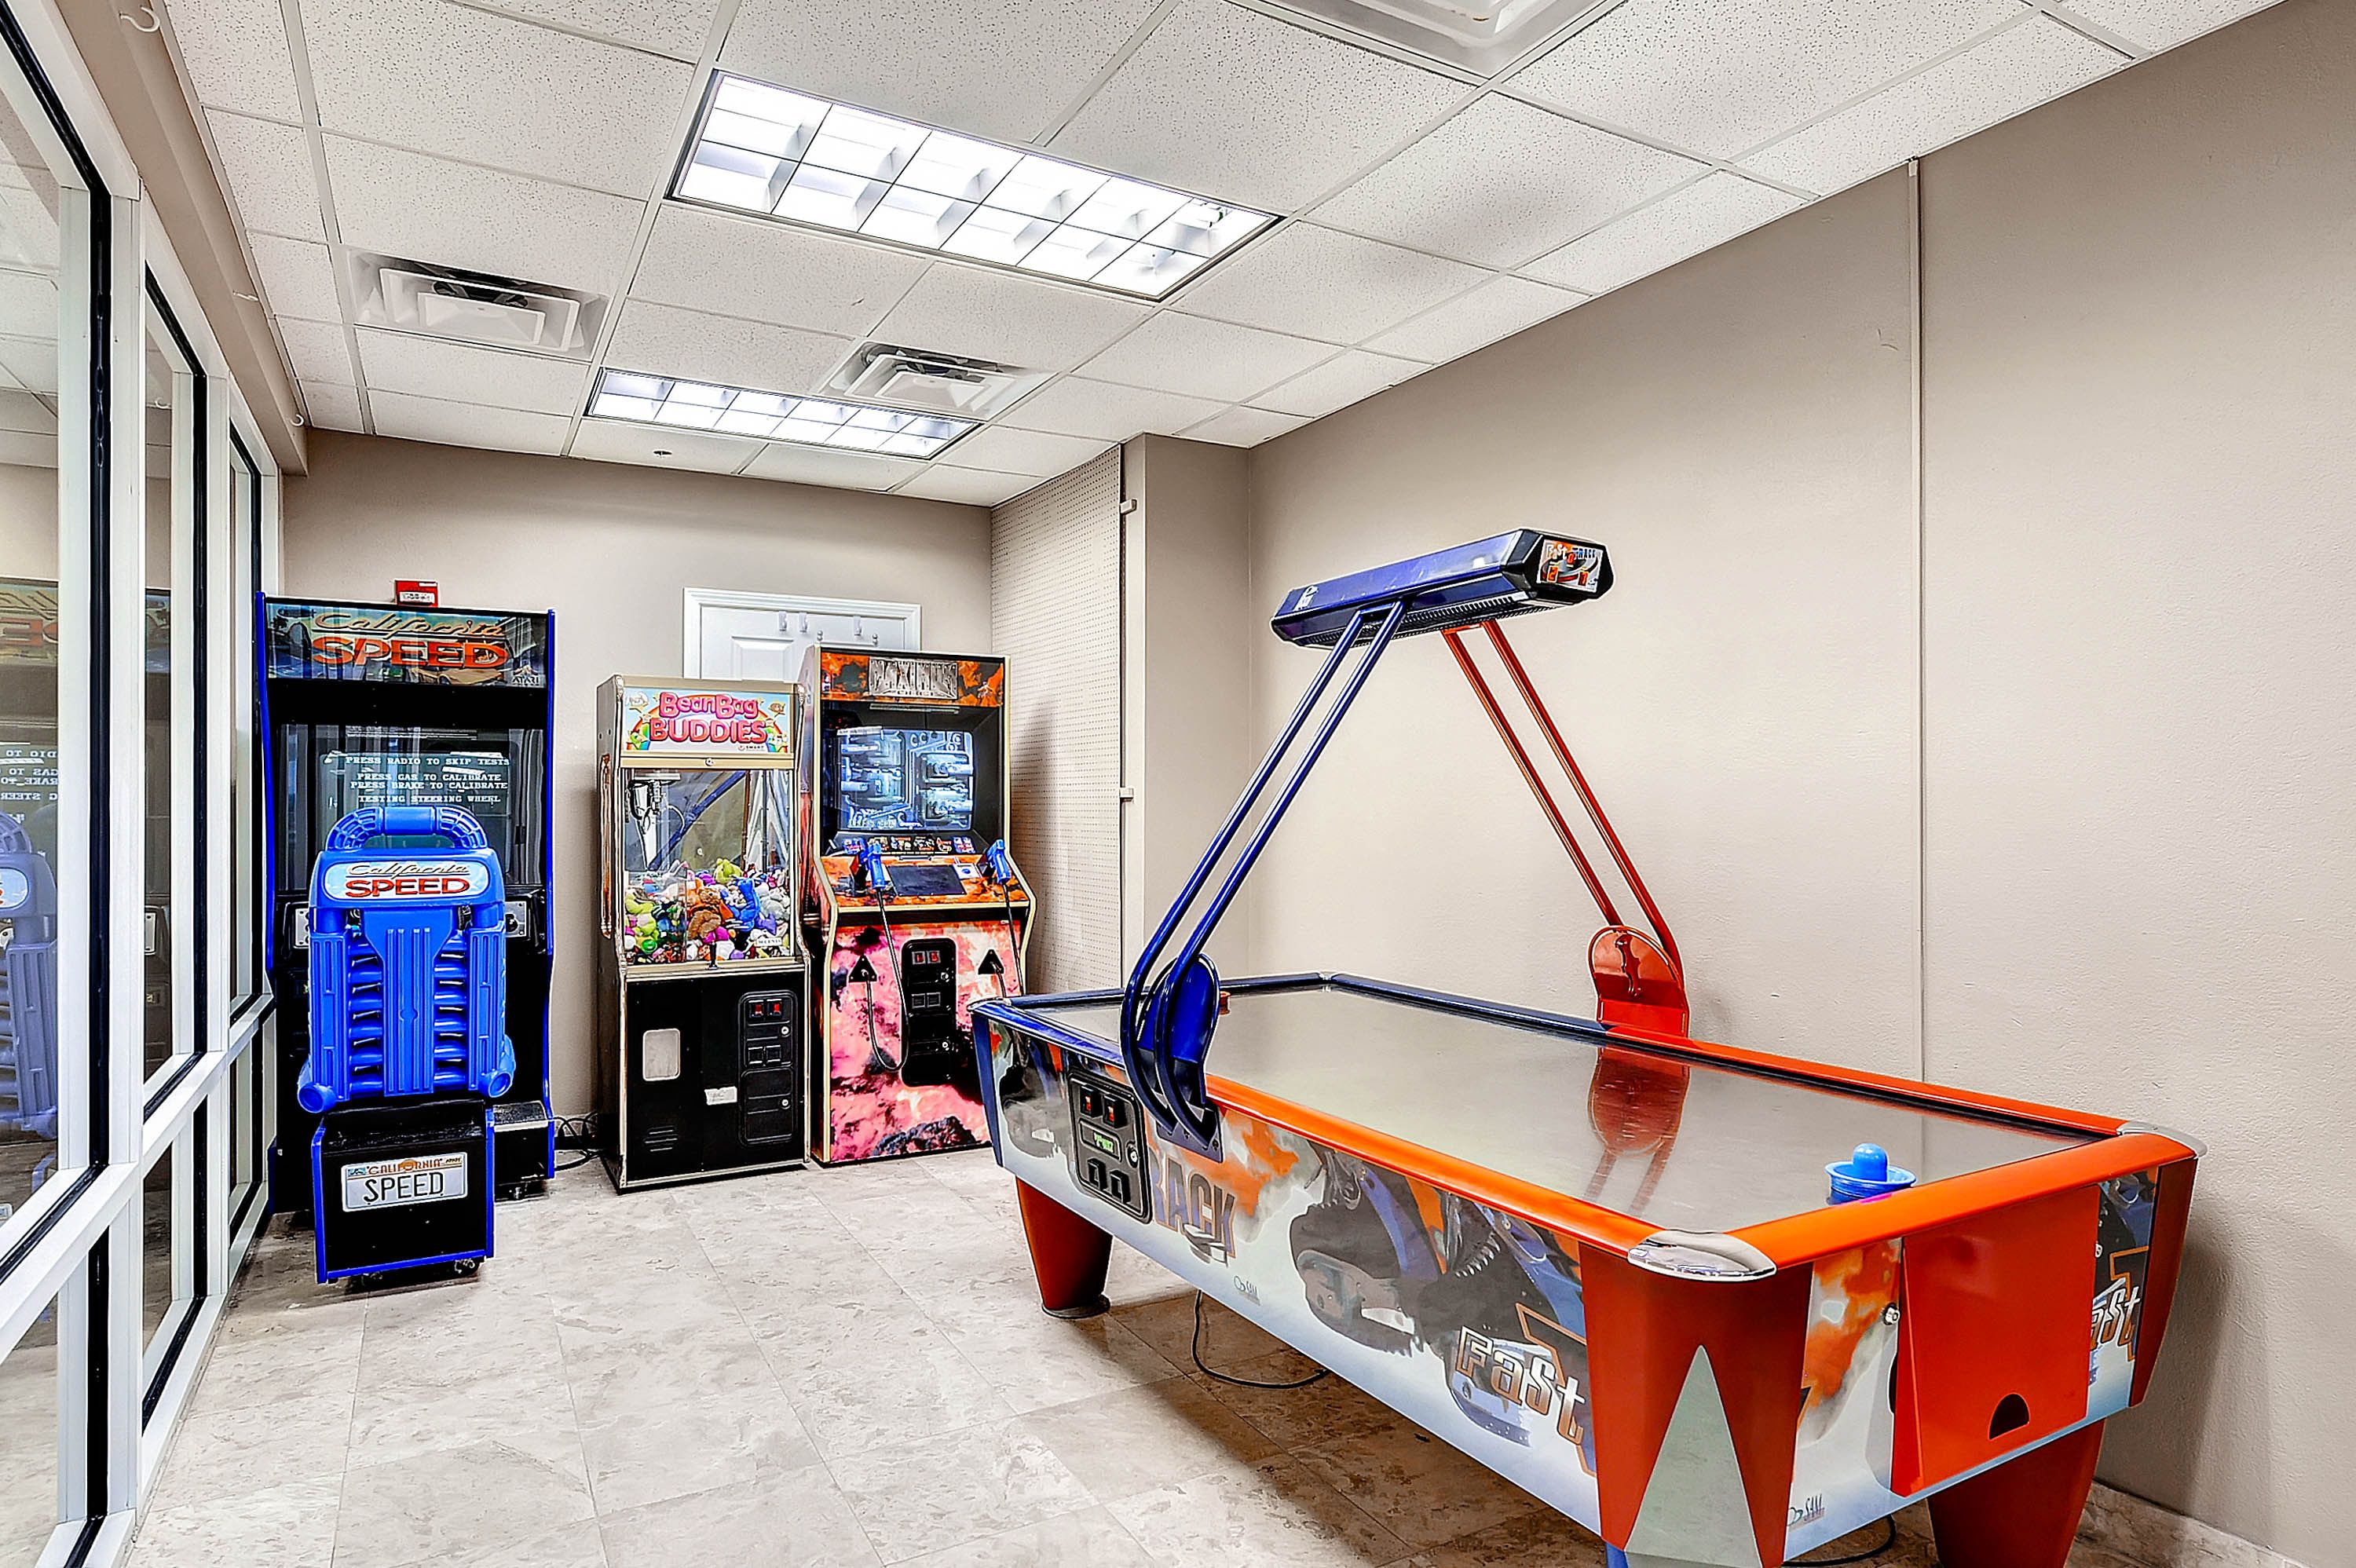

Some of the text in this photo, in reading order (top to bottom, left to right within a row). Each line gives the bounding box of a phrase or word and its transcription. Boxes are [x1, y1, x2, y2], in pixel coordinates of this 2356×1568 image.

[314, 613, 504, 638] California
[312, 636, 510, 668] SPEED
[512, 675, 540, 684] ATARI
[649, 718, 768, 744] BUDDIES
[345, 756, 382, 766] PRESS
[387, 757, 421, 766] RADIO
[426, 757, 440, 766] TO
[357, 773, 392, 781] PRESS
[442, 773, 502, 782] CALIBRATE
[348, 863, 470, 879] California
[346, 877, 470, 897] SPEED
[368, 1158, 441, 1175] CALIFORNIA
[363, 1171, 444, 1203] SPEED
[2090, 1286, 2141, 1351] ast
[1455, 1325, 1586, 1446] Fast
